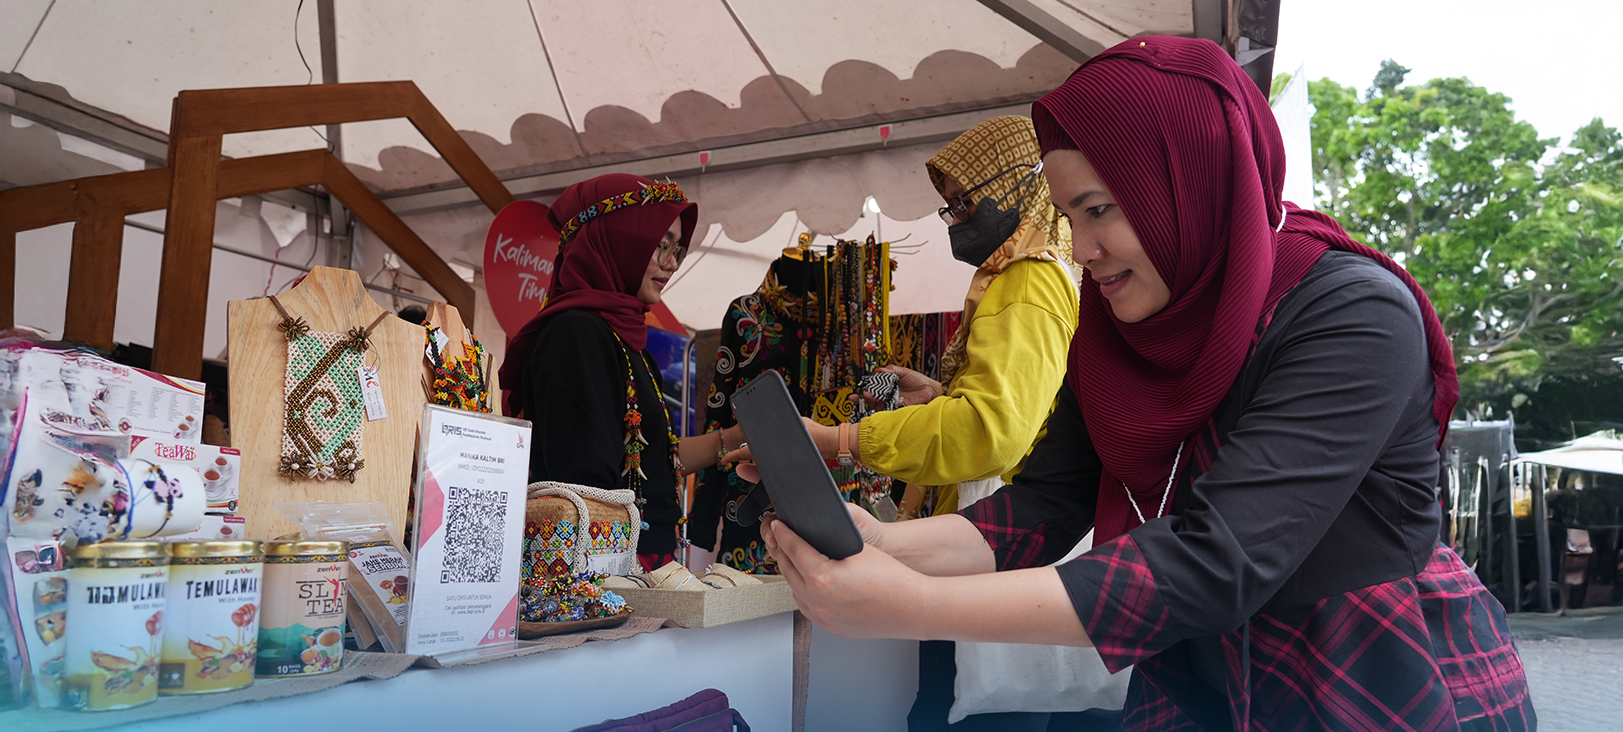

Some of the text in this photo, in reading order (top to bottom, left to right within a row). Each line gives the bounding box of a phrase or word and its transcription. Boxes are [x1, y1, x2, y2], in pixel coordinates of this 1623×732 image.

[518, 273, 547, 303] Tim
[441, 424, 462, 436] QRIS
[307, 598, 344, 614] TEA
[277, 665, 289, 674] 10
